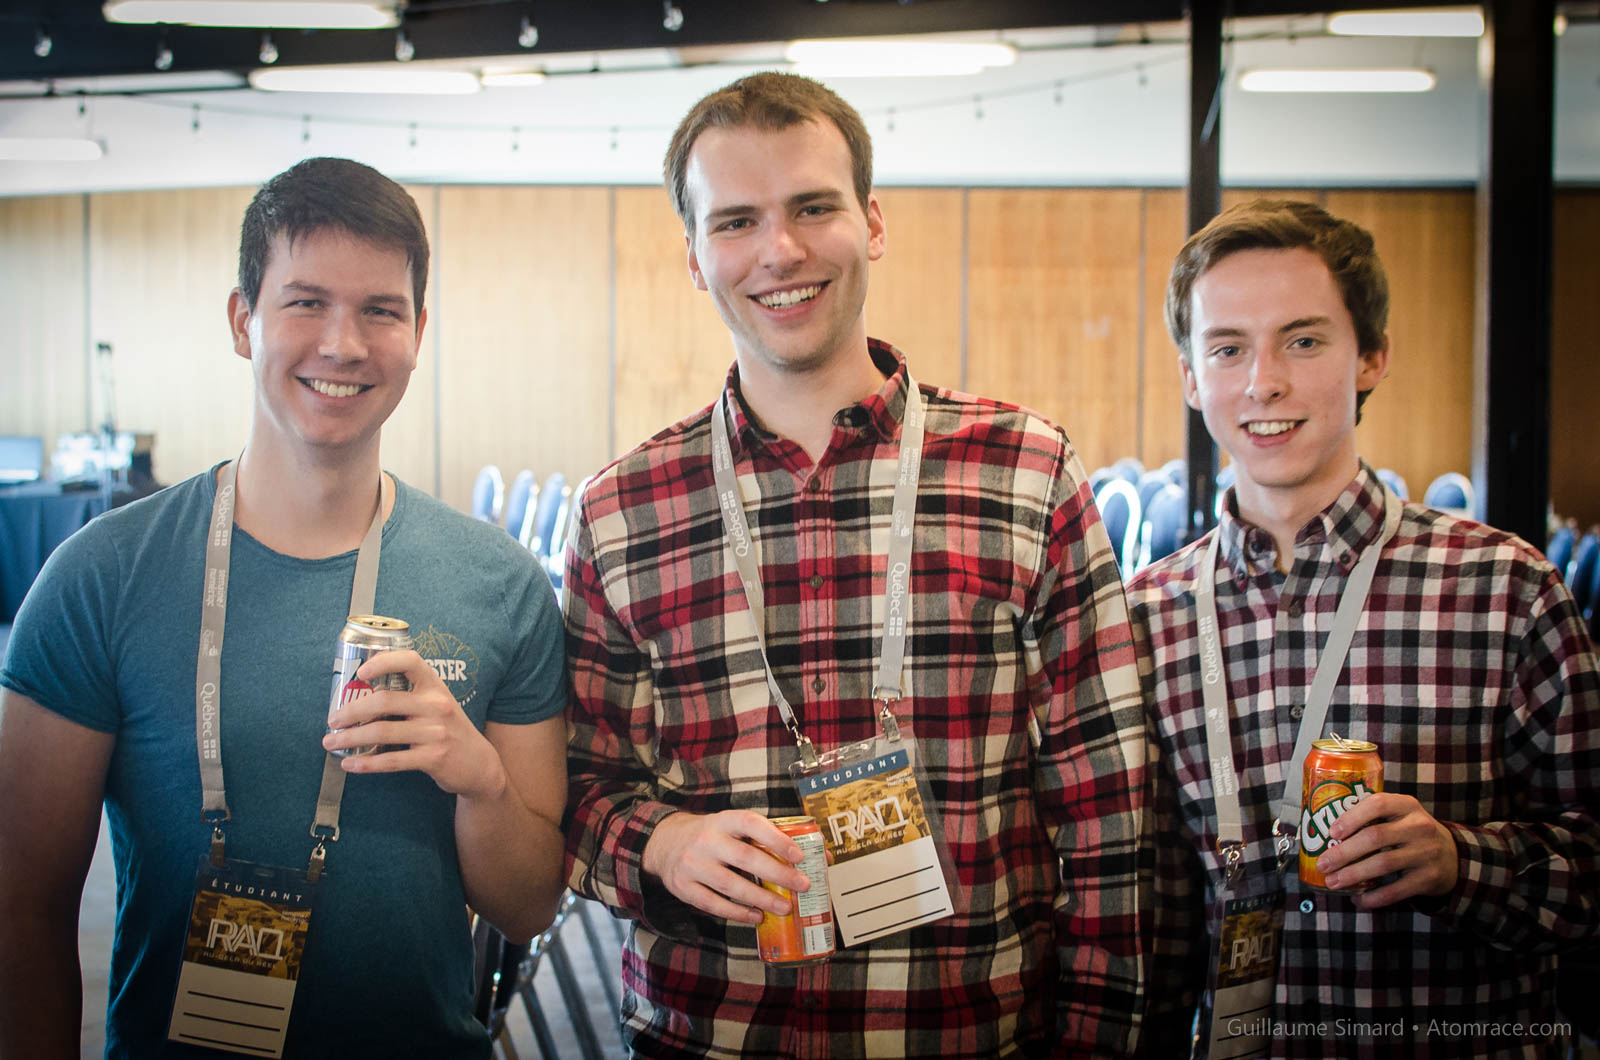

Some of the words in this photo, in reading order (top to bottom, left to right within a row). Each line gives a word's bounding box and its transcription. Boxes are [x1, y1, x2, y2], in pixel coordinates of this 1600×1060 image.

[216, 485, 233, 529] Québec
[729, 507, 747, 556] Québec
[890, 562, 906, 615] Québec
[1205, 634, 1220, 685] Québec
[200, 682, 216, 738] Québec
[811, 755, 898, 789] ÉTUDIANT
[211, 877, 302, 903] ÉTUDIANT
